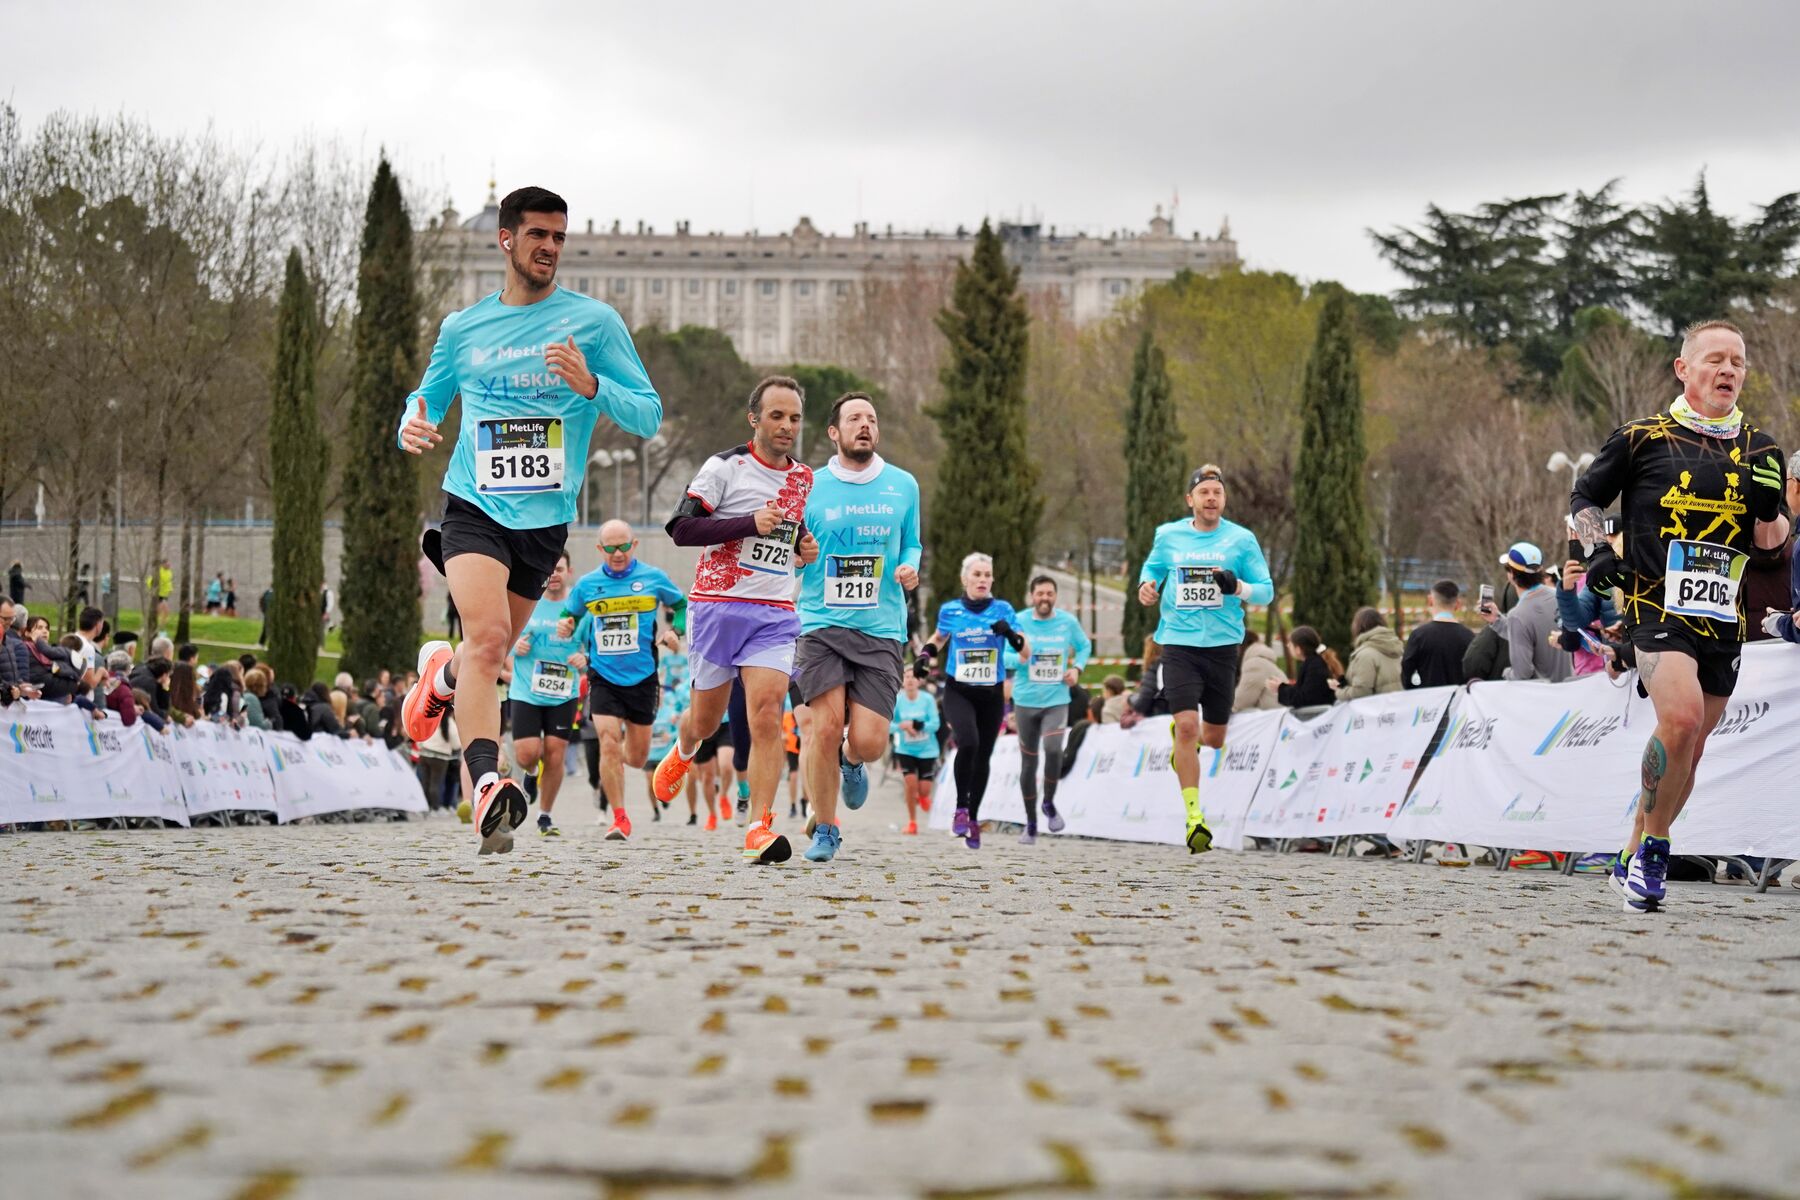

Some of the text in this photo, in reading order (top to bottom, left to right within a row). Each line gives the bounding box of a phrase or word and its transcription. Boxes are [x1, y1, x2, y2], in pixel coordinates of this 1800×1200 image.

[497, 344, 546, 361] MetLi
[478, 376, 509, 402] XI
[511, 373, 561, 388] 15KM
[509, 423, 545, 432] MetLife
[491, 455, 550, 479] 5183
[845, 504, 894, 515] MetLife
[831, 527, 854, 547] XI
[856, 525, 891, 537] 15KM
[752, 543, 790, 566] 5725
[848, 559, 873, 567] MetLife
[835, 582, 874, 599] 1218
[1183, 588, 1216, 601] 3582
[1679, 578, 1730, 606] 6206
[602, 634, 632, 647] 6773
[963, 667, 991, 679] 4710
[539, 678, 566, 692] 6254
[24, 724, 55, 750] MetLife
[1555, 715, 1620, 748] MetLife
[1224, 744, 1260, 772] MetLife
